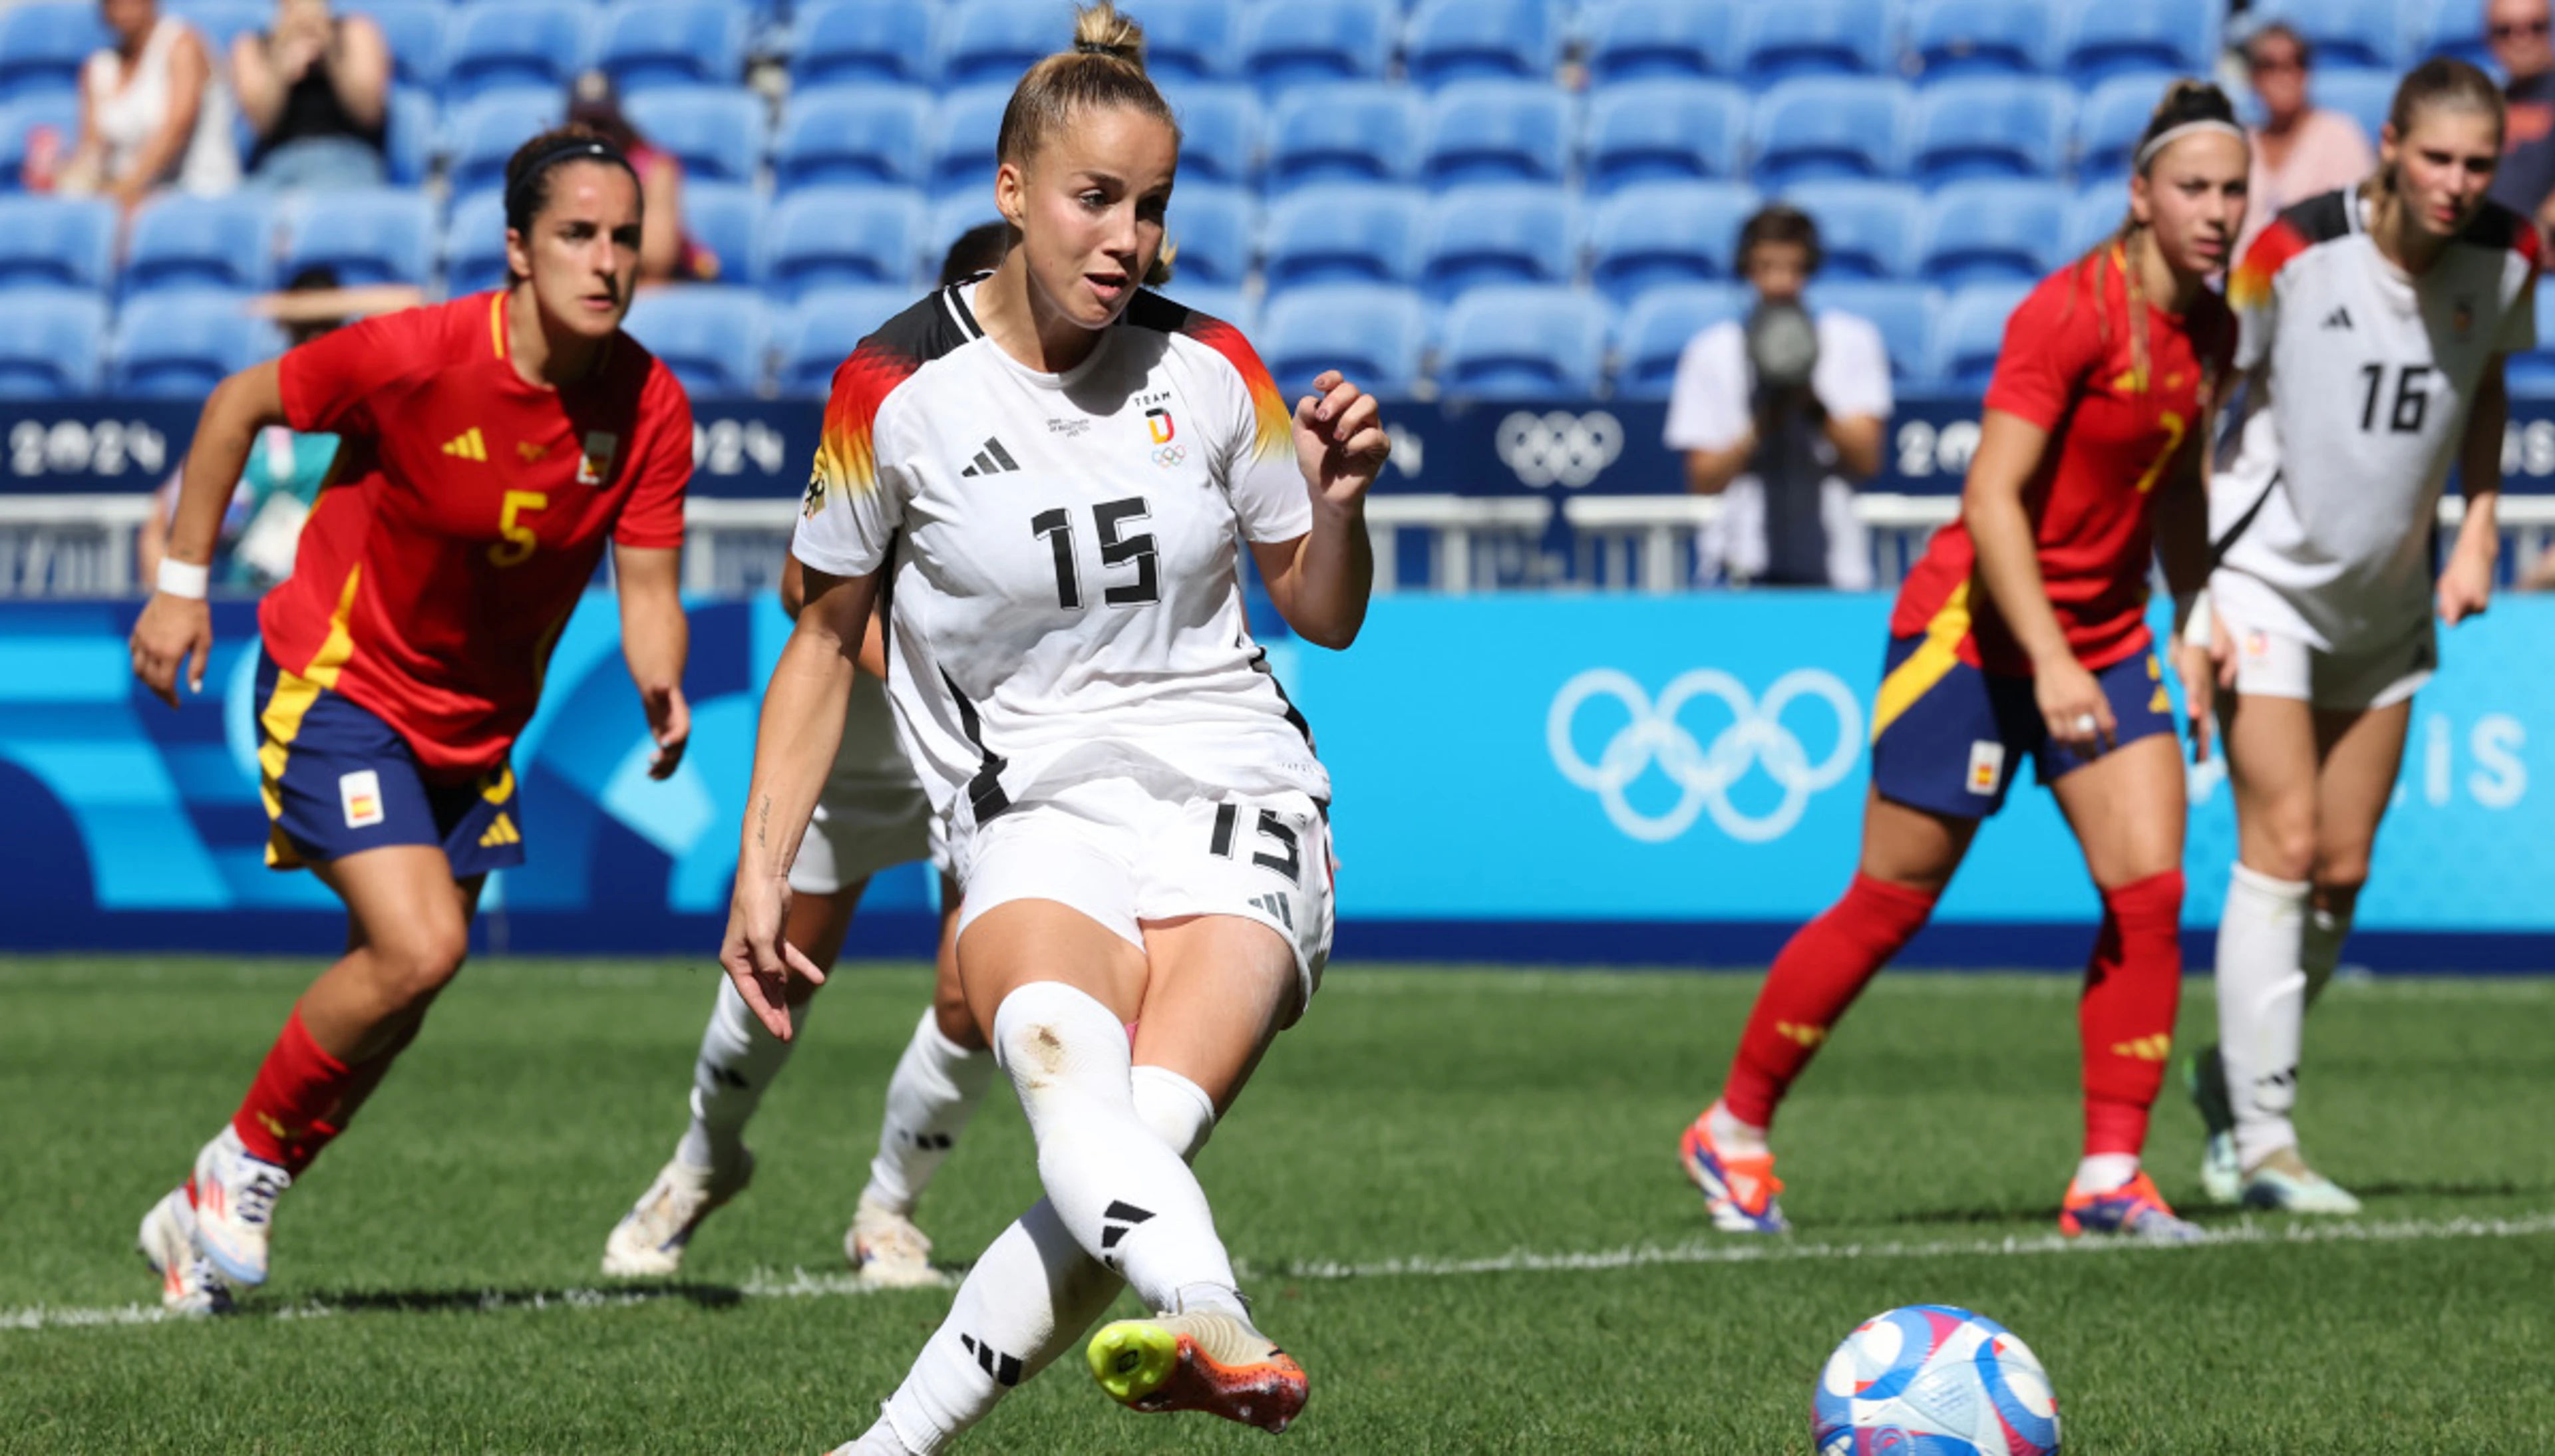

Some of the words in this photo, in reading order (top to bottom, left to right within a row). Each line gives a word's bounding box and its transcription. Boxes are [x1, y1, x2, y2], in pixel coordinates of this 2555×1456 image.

[1134, 391, 1170, 406] TEAM
[2361, 363, 2430, 432] 16
[10, 420, 165, 474] 2024
[2136, 411, 2184, 493] 7
[487, 490, 548, 567] 5
[1031, 496, 1162, 610] 15
[1210, 803, 1303, 891] 15
